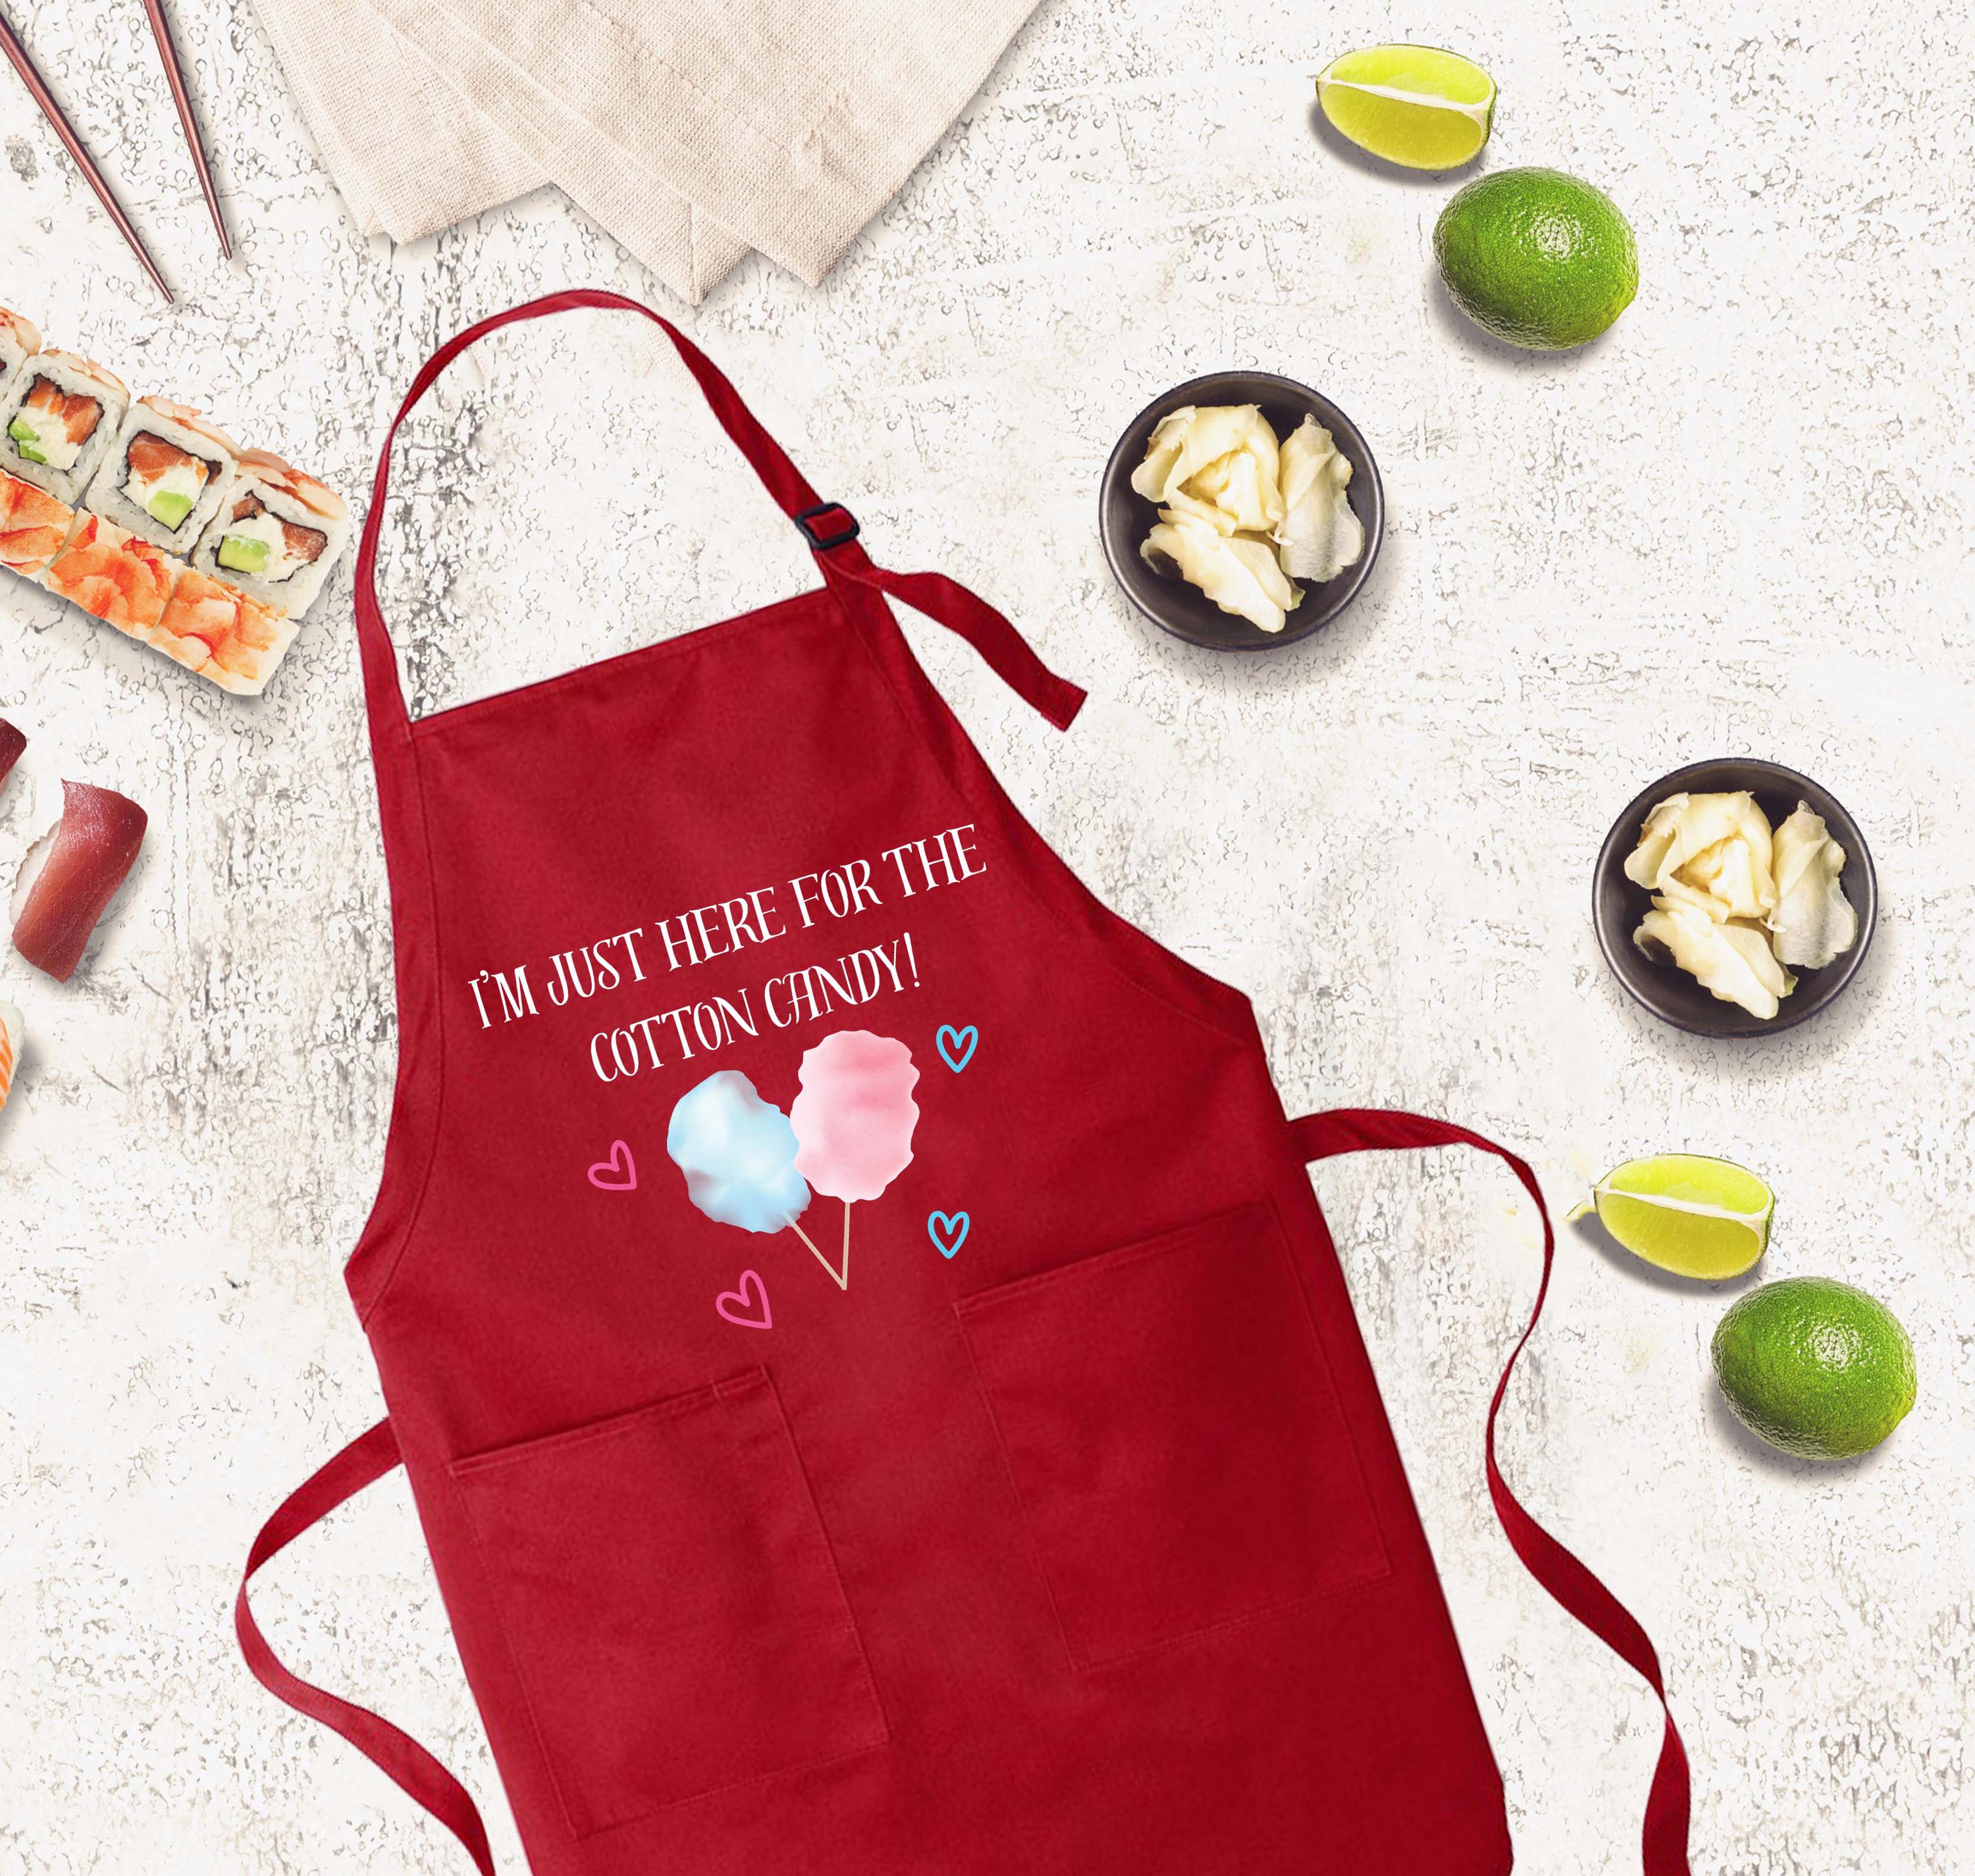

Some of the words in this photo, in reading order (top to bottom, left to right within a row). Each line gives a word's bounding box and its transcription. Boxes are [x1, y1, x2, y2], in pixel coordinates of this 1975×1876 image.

[467, 964, 540, 1029] I'M
[547, 927, 647, 1006] JUST
[654, 886, 787, 972] HERE
[787, 859, 883, 929] FOR
[881, 823, 987, 898] THE
[591, 987, 759, 1082] COTTON
[764, 931, 920, 1028] CANDY!
